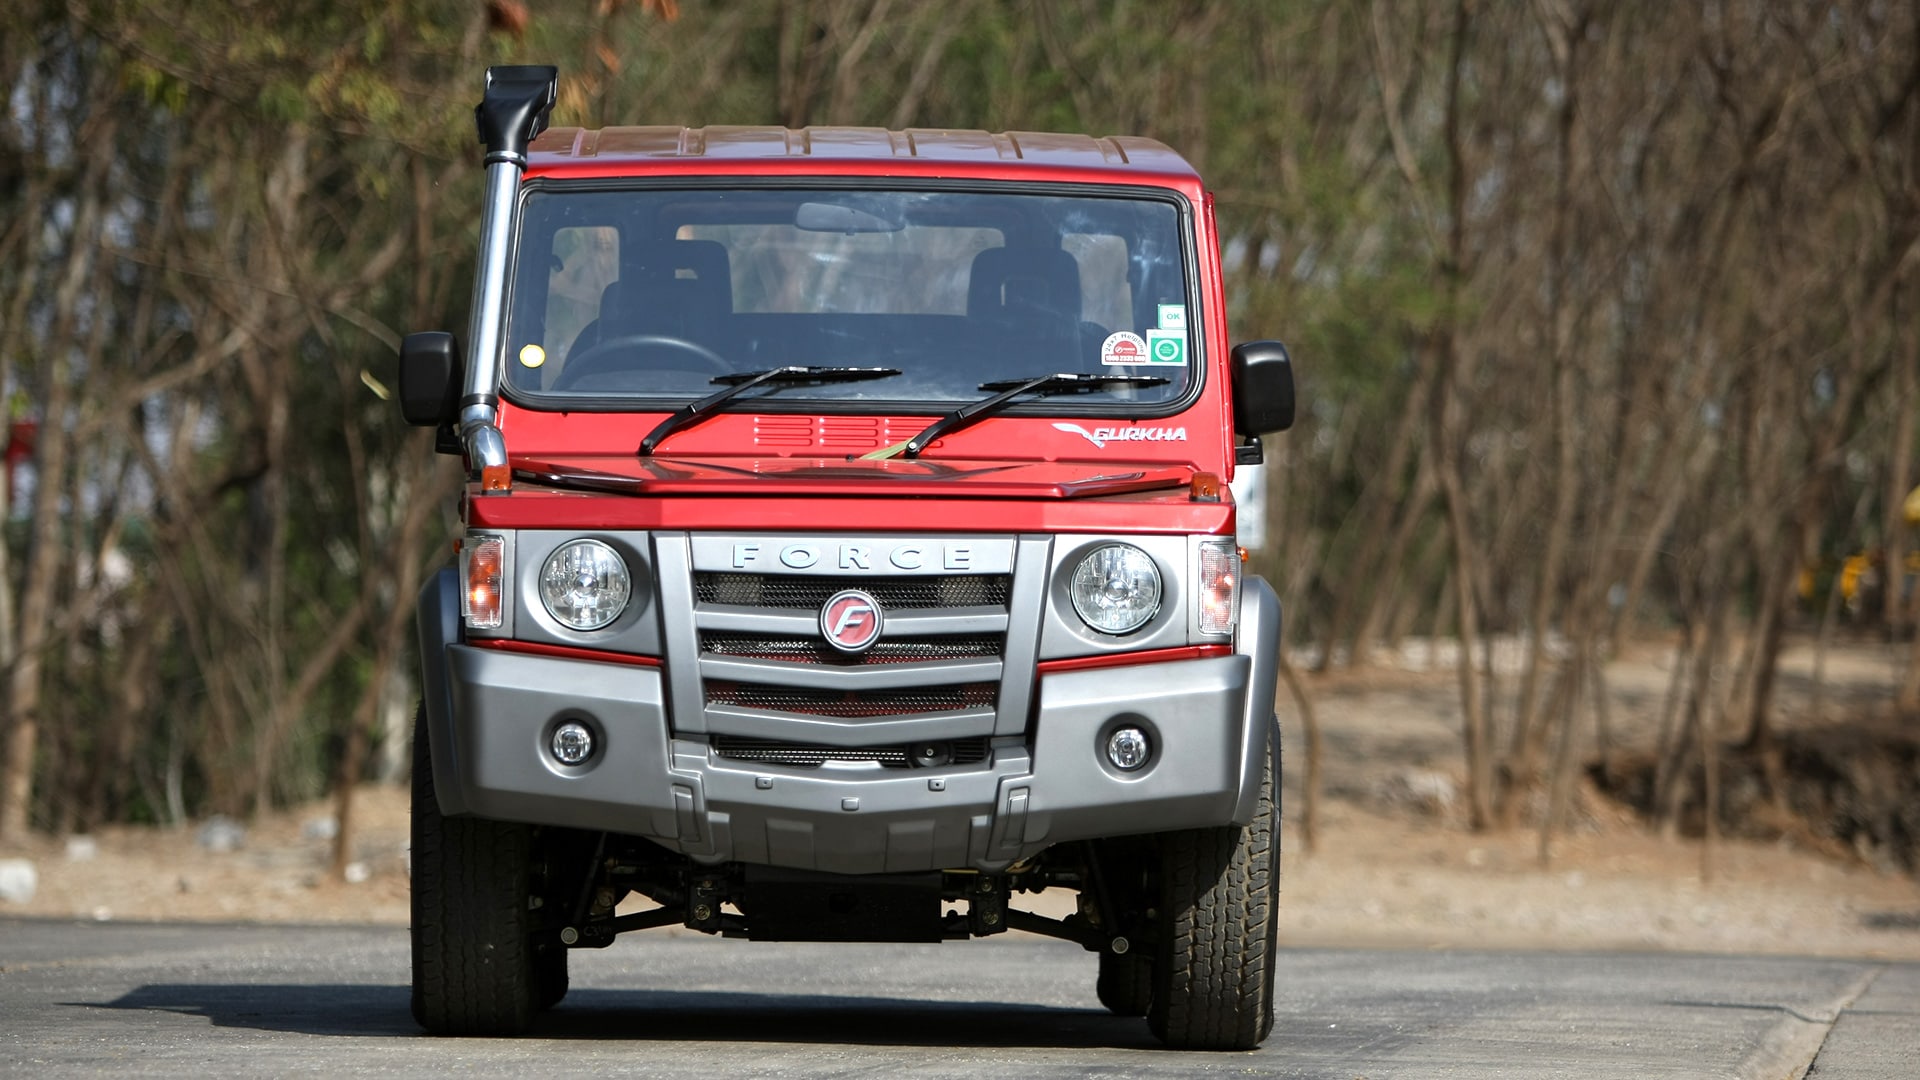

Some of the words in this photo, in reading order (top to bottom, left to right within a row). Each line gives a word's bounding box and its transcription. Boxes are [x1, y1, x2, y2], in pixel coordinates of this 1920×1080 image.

[1120, 333, 1145, 354] Helpline
[1093, 427, 1186, 440] GURKHA
[732, 543, 971, 570] FORCE
[832, 605, 874, 637] F
